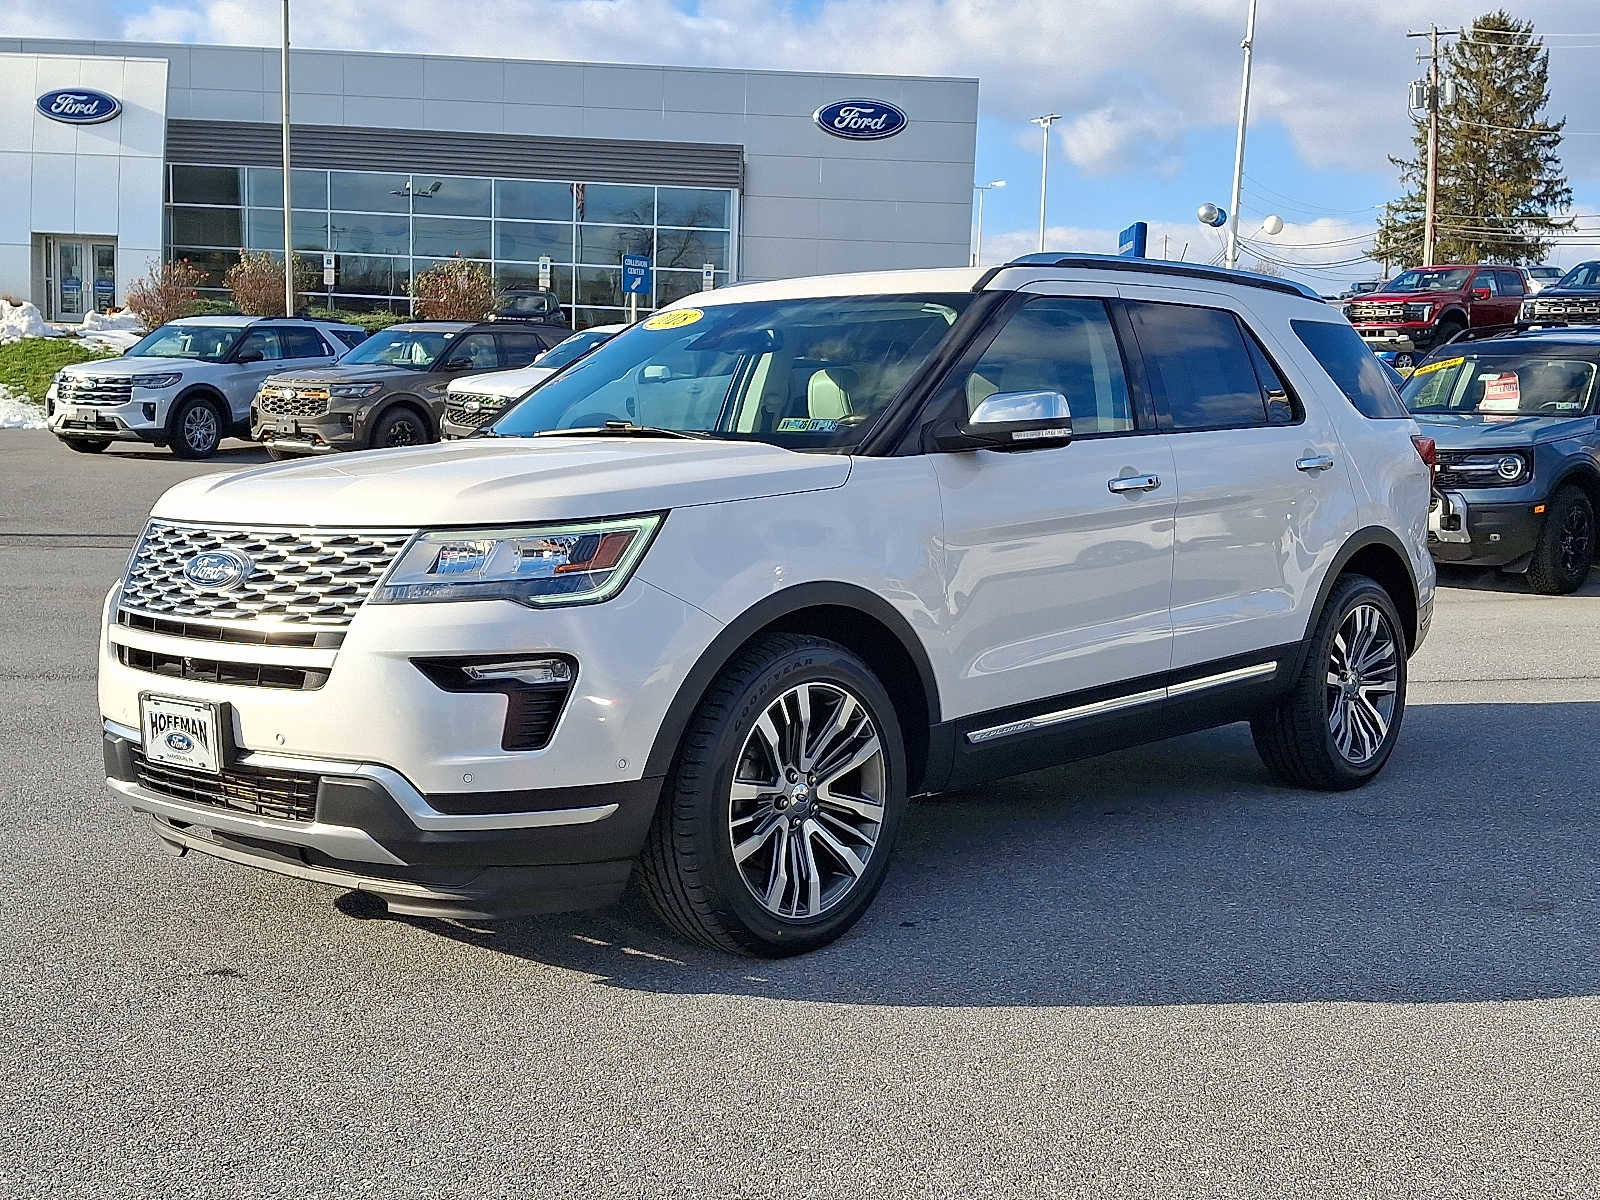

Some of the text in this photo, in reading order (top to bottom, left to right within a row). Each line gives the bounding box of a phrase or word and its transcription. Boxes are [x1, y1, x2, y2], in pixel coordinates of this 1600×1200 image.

[51, 94, 99, 114] Ford
[834, 107, 888, 129] Ford
[624, 258, 648, 267] COLLISION
[627, 267, 645, 275] CENTER
[1535, 306, 1599, 314] FORD
[190, 557, 224, 580] Ford
[734, 658, 813, 732] GOODYEAR
[150, 713, 209, 749] HOFFMAN
[974, 722, 1032, 740] EXPLORER
[170, 735, 188, 750] Ford
